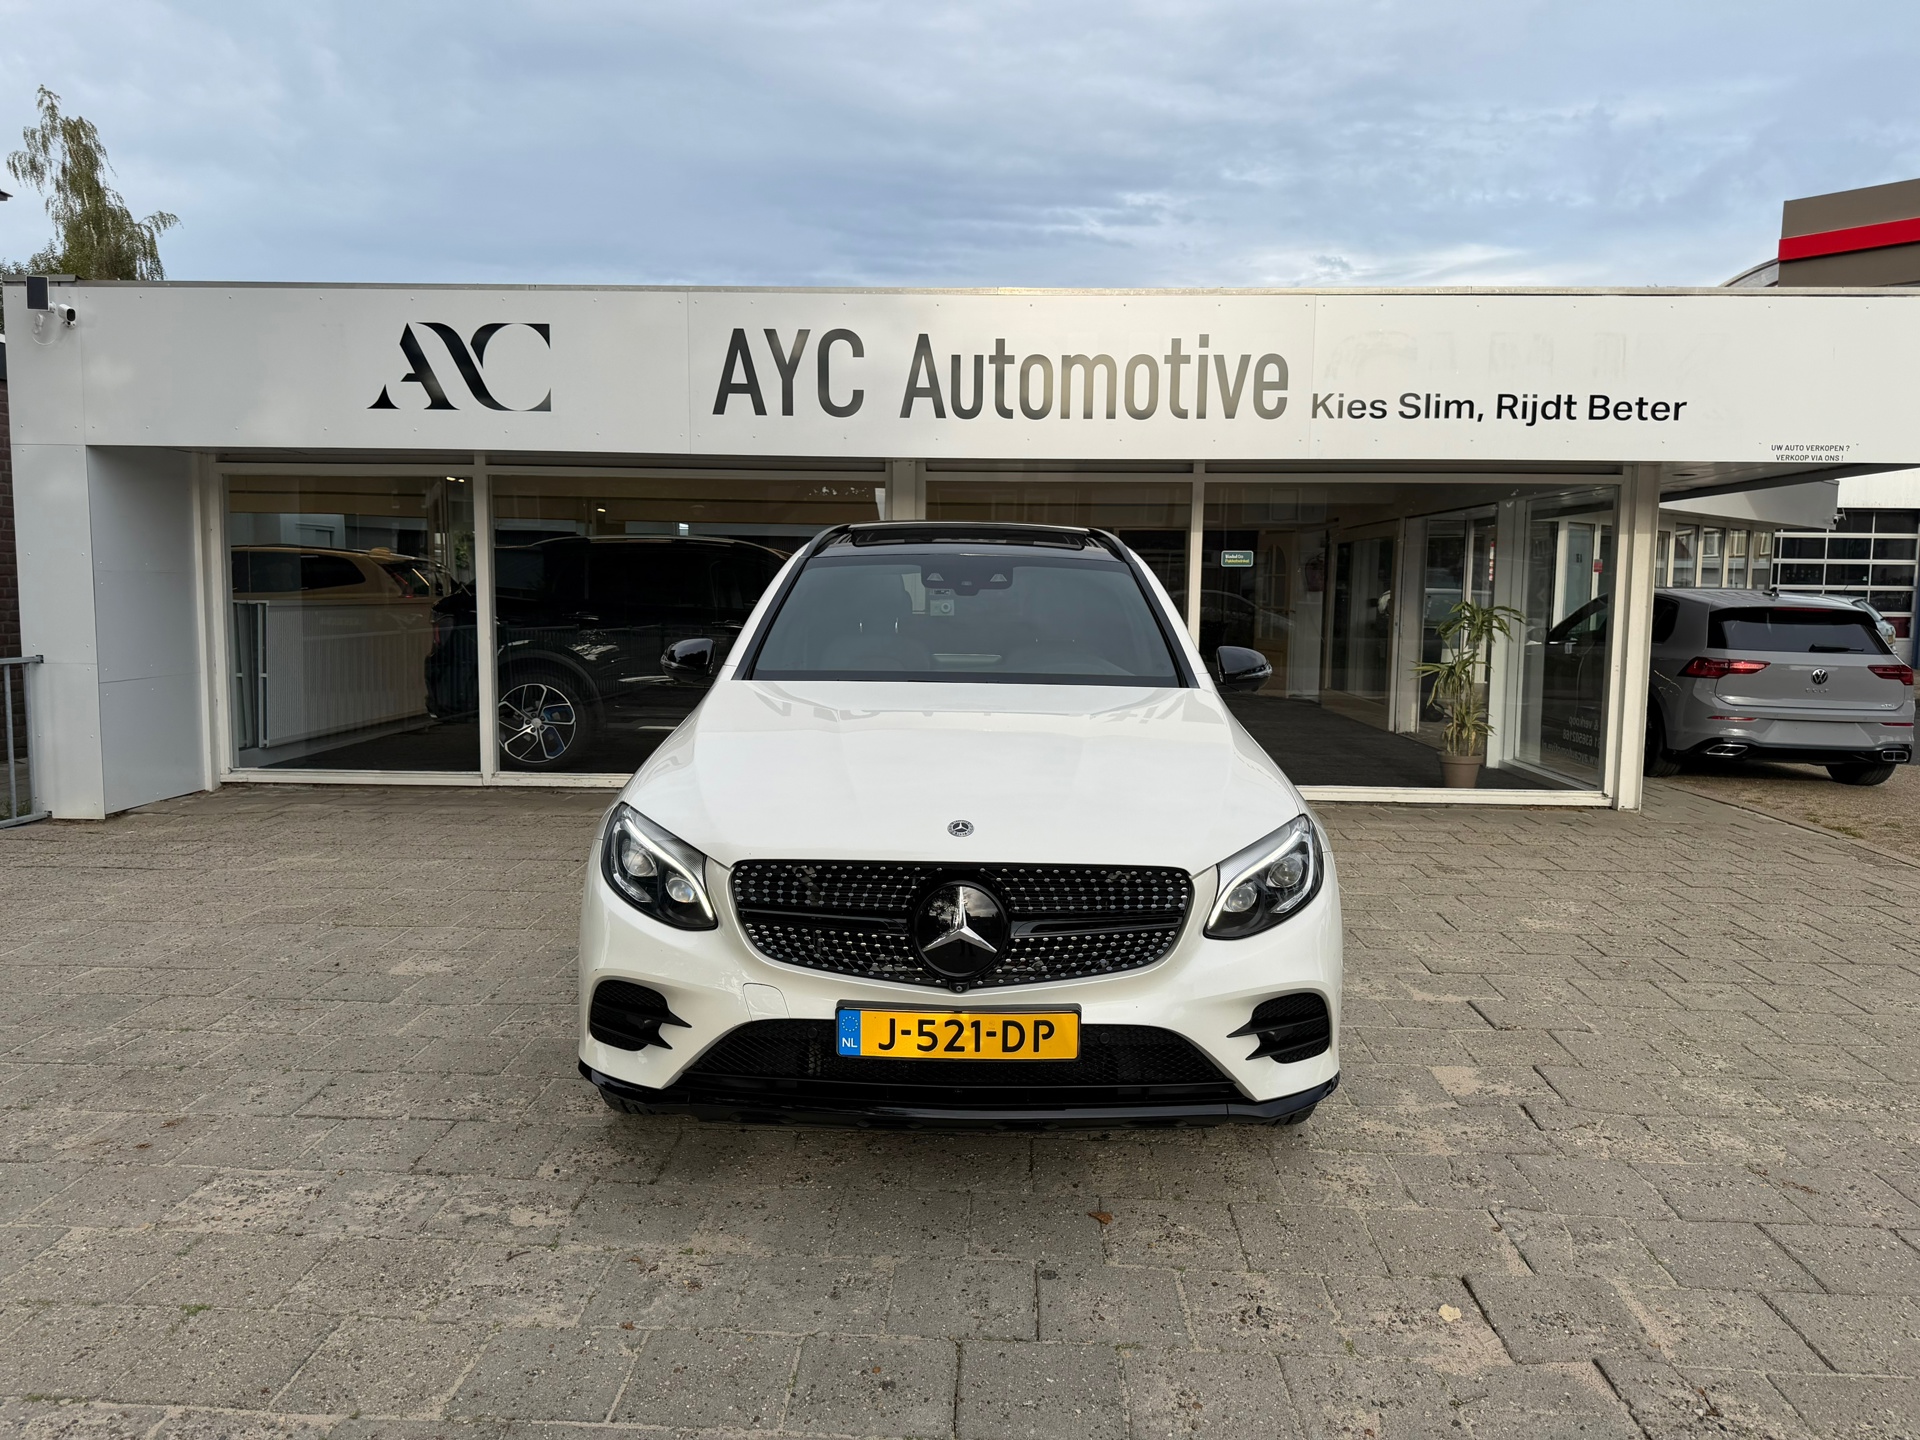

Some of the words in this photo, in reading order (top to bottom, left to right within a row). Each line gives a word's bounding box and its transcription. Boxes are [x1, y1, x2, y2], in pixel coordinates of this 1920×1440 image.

[713, 328, 865, 418] AYC
[900, 334, 1289, 420] Automotive
[1311, 393, 1388, 420] Kies
[1398, 393, 1484, 423] Slim,
[1496, 394, 1578, 427] Rijdt
[1588, 395, 1688, 422] Beter
[1805, 444, 1845, 452] VERKOPEN
[842, 1038, 858, 1048] NL
[878, 1018, 1055, 1053] J-521-DP
